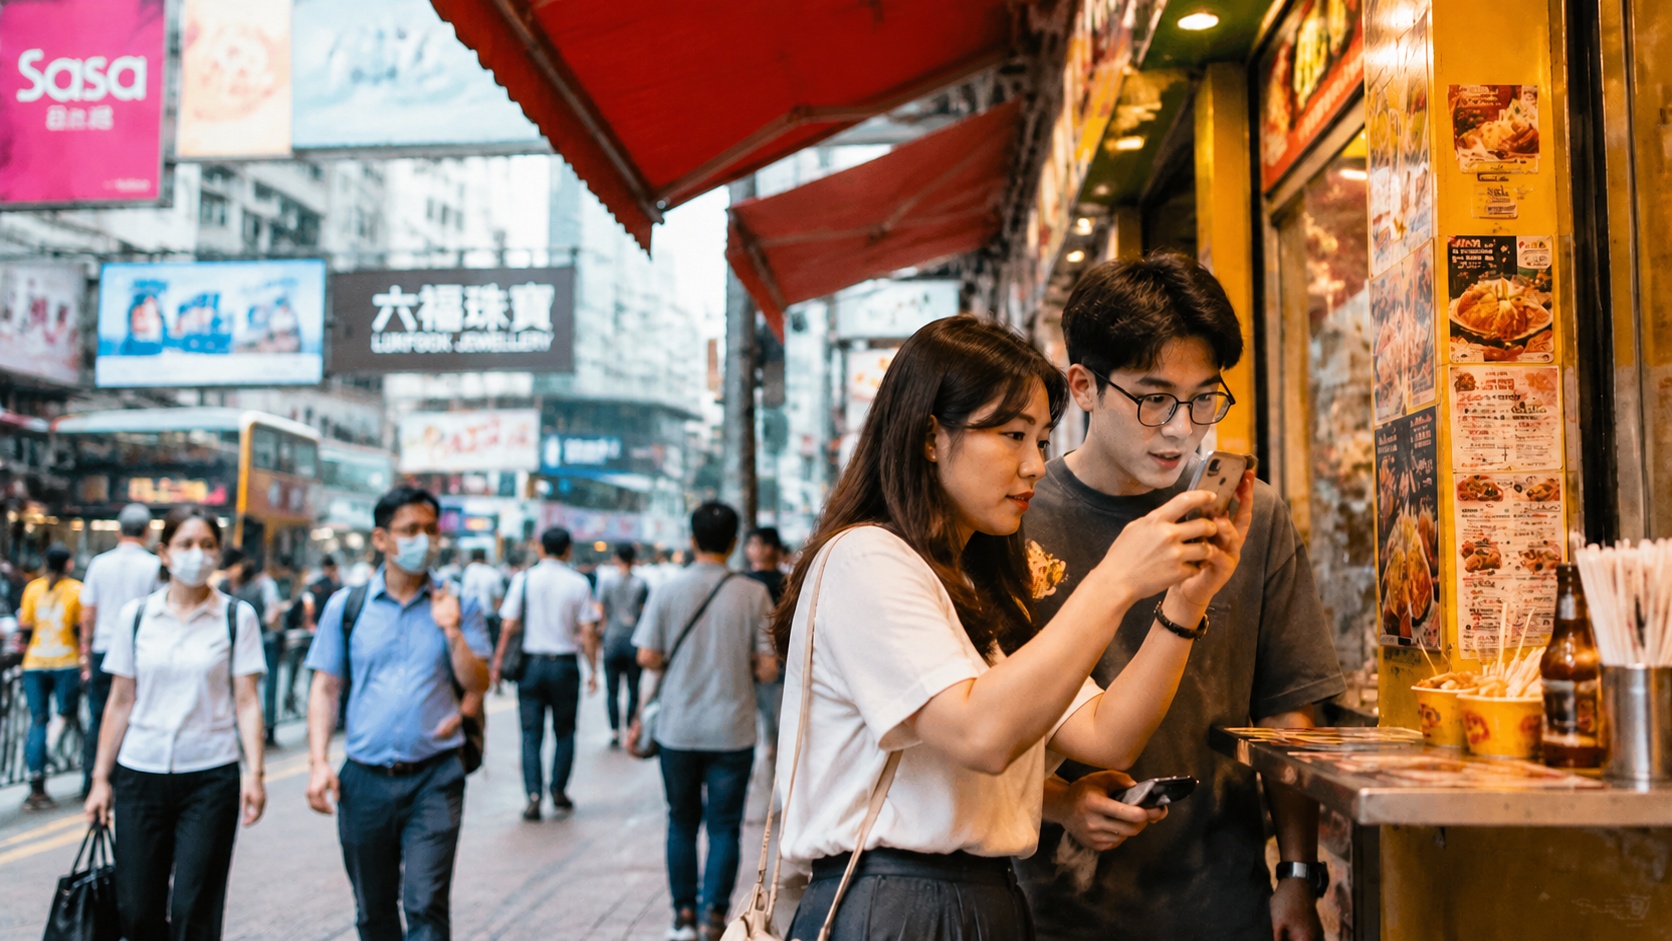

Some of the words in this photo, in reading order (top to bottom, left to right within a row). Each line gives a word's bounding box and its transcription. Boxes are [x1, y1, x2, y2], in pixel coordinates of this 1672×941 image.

[16, 48, 147, 102] Sasa
[371, 281, 555, 332] 六福珠寶
